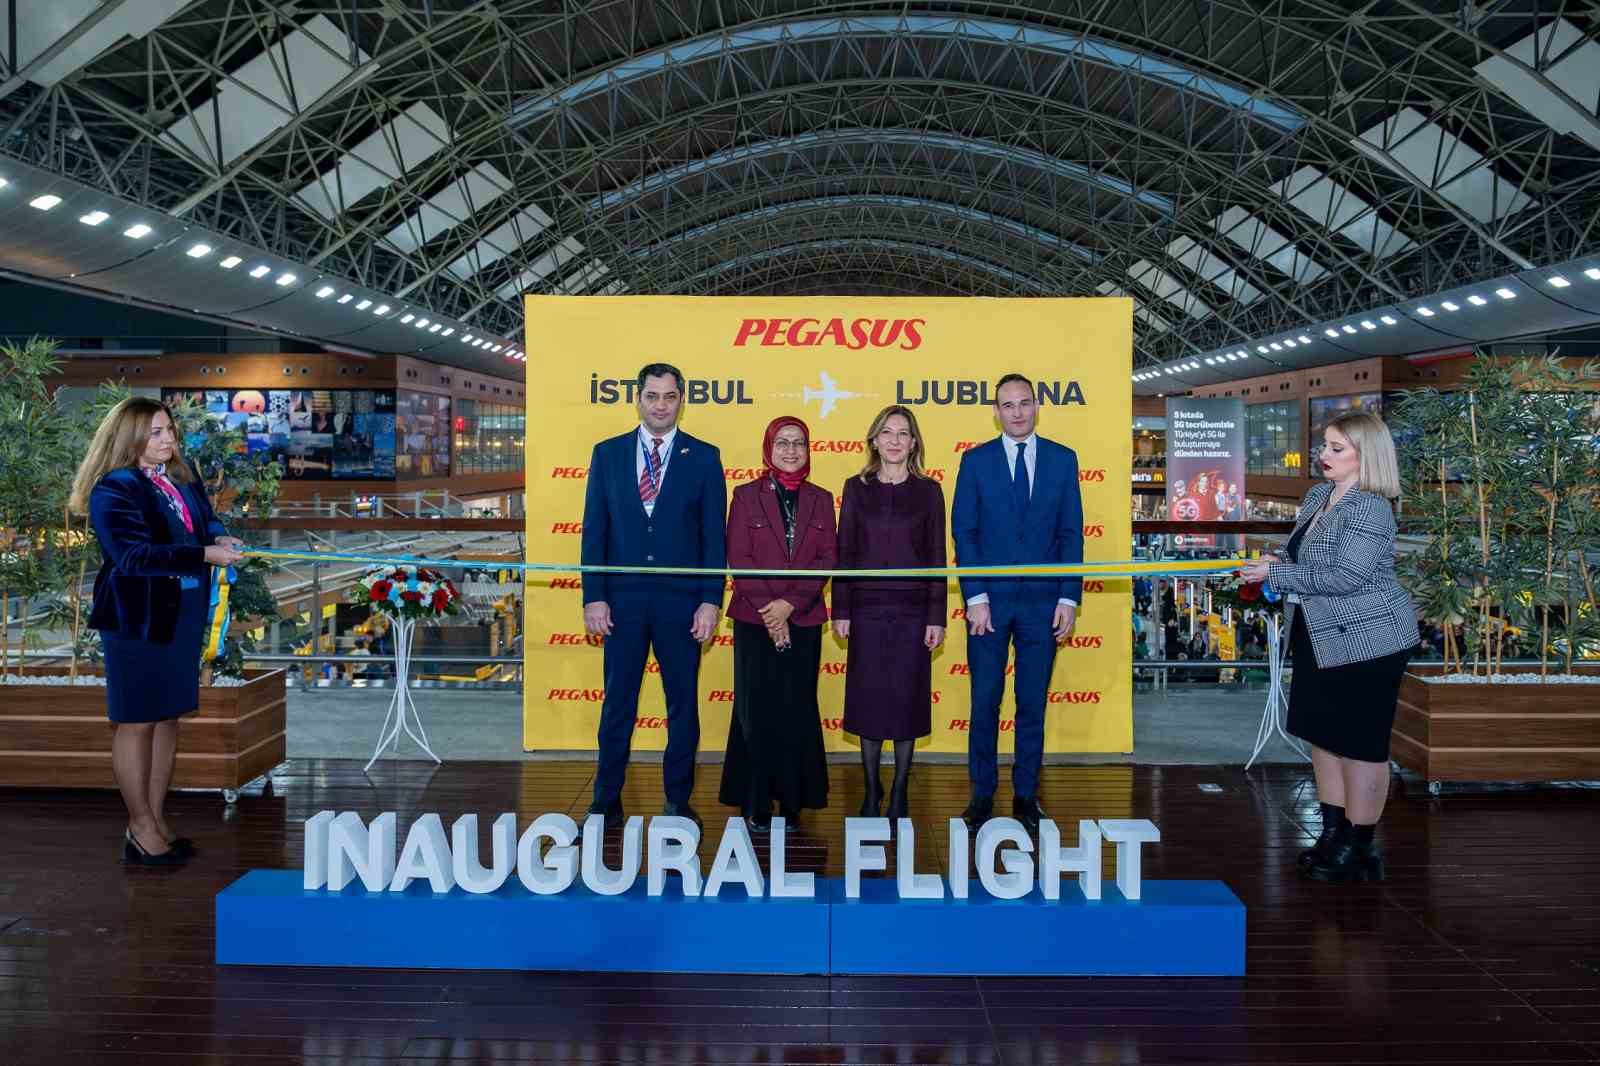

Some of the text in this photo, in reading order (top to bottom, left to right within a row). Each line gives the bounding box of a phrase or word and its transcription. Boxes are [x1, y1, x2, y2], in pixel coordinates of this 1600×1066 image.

[733, 318, 926, 350] PEGASUS
[590, 373, 1086, 406] İSTBUL LJUBLNA
[811, 440, 864, 453] GASUS
[549, 633, 604, 647] PEGAS
[548, 689, 604, 702] PEGAS
[1047, 691, 1101, 704] GASUS
[303, 810, 1160, 900] INAUGURAL FLIGHT
